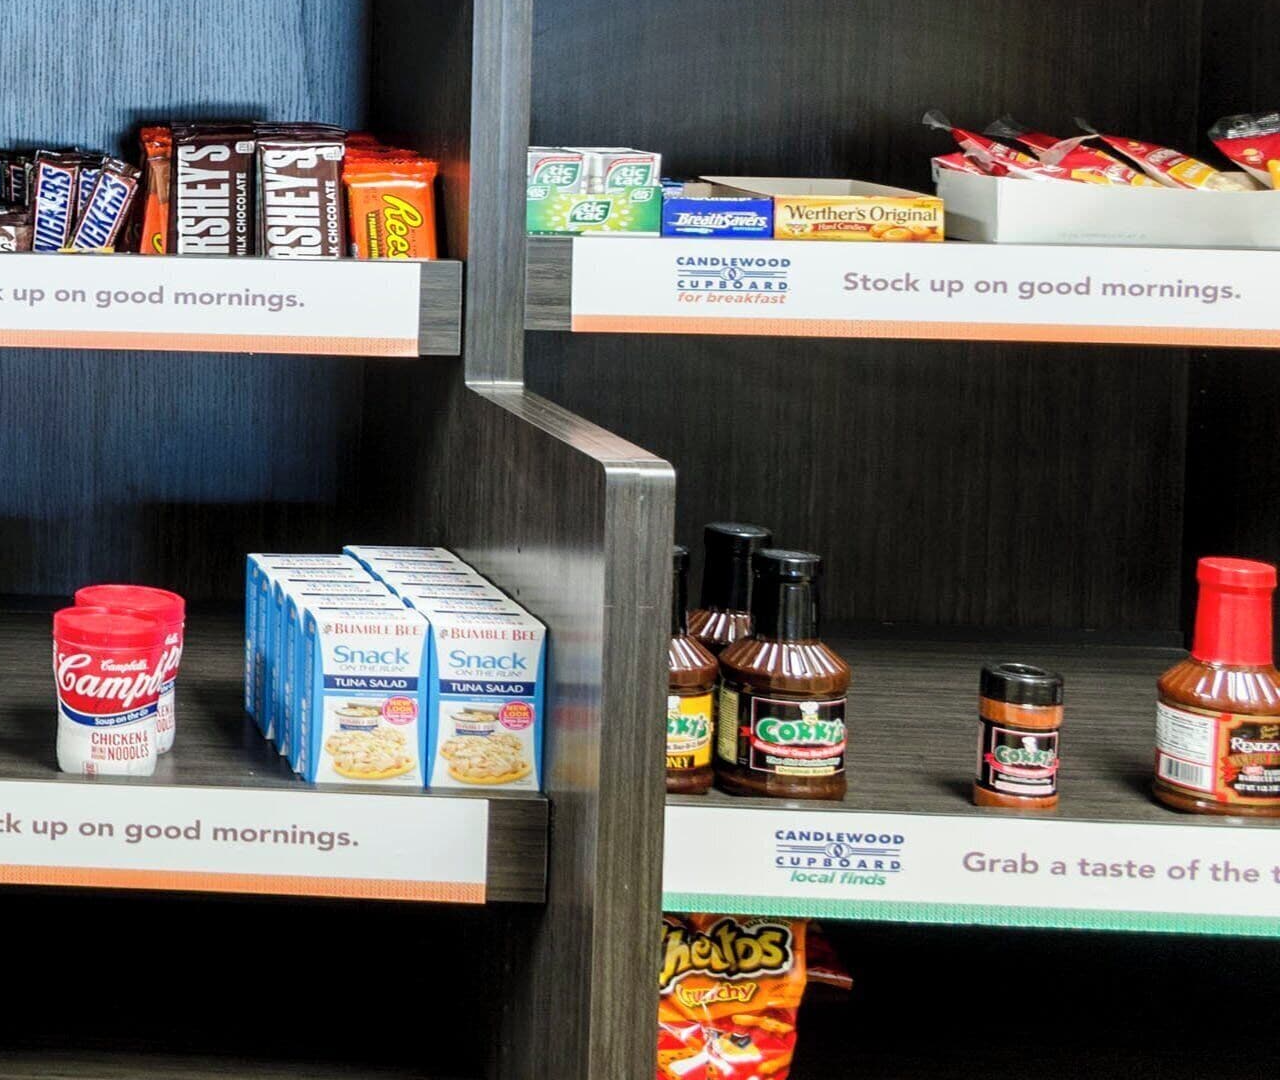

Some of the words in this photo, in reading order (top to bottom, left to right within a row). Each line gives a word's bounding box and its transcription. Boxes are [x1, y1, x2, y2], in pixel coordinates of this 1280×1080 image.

[235, 172, 247, 234] CHOCOLATE
[675, 212, 769, 228] BreathSavers
[787, 204, 864, 221] Werther's
[869, 205, 938, 223] Original
[675, 255, 792, 268] CANDLEWOOD
[676, 279, 789, 291] CUPBOARD
[842, 271, 921, 293] Stock
[929, 279, 965, 299] up
[973, 279, 1008, 294] on
[1017, 275, 1092, 301] good
[1101, 279, 1241, 305] mornings.
[12, 288, 46, 307] up
[54, 289, 87, 303] on
[95, 284, 164, 309] good
[173, 287, 305, 313] mornings.
[676, 291, 703, 304] for
[705, 292, 788, 305] breakfast
[335, 622, 392, 637] BUMBLE
[394, 624, 421, 636] BEE
[333, 645, 410, 666] Snack
[335, 678, 367, 689] TUNA
[369, 679, 407, 690] SALAD
[91, 731, 141, 747] CHICKEN
[106, 742, 150, 761] NOODLES
[32, 820, 69, 841] up
[78, 822, 114, 838] on
[124, 819, 201, 845] good
[212, 823, 359, 852] mornings.
[774, 829, 905, 845] CANDLEWOOD
[775, 855, 902, 871] CUPBOARD
[962, 851, 1040, 875] Grab
[1049, 860, 1067, 876] a
[1077, 857, 1156, 879] taste
[1166, 858, 1201, 881] of
[1209, 860, 1261, 883] the
[789, 870, 835, 884] local
[839, 872, 887, 887] finds
